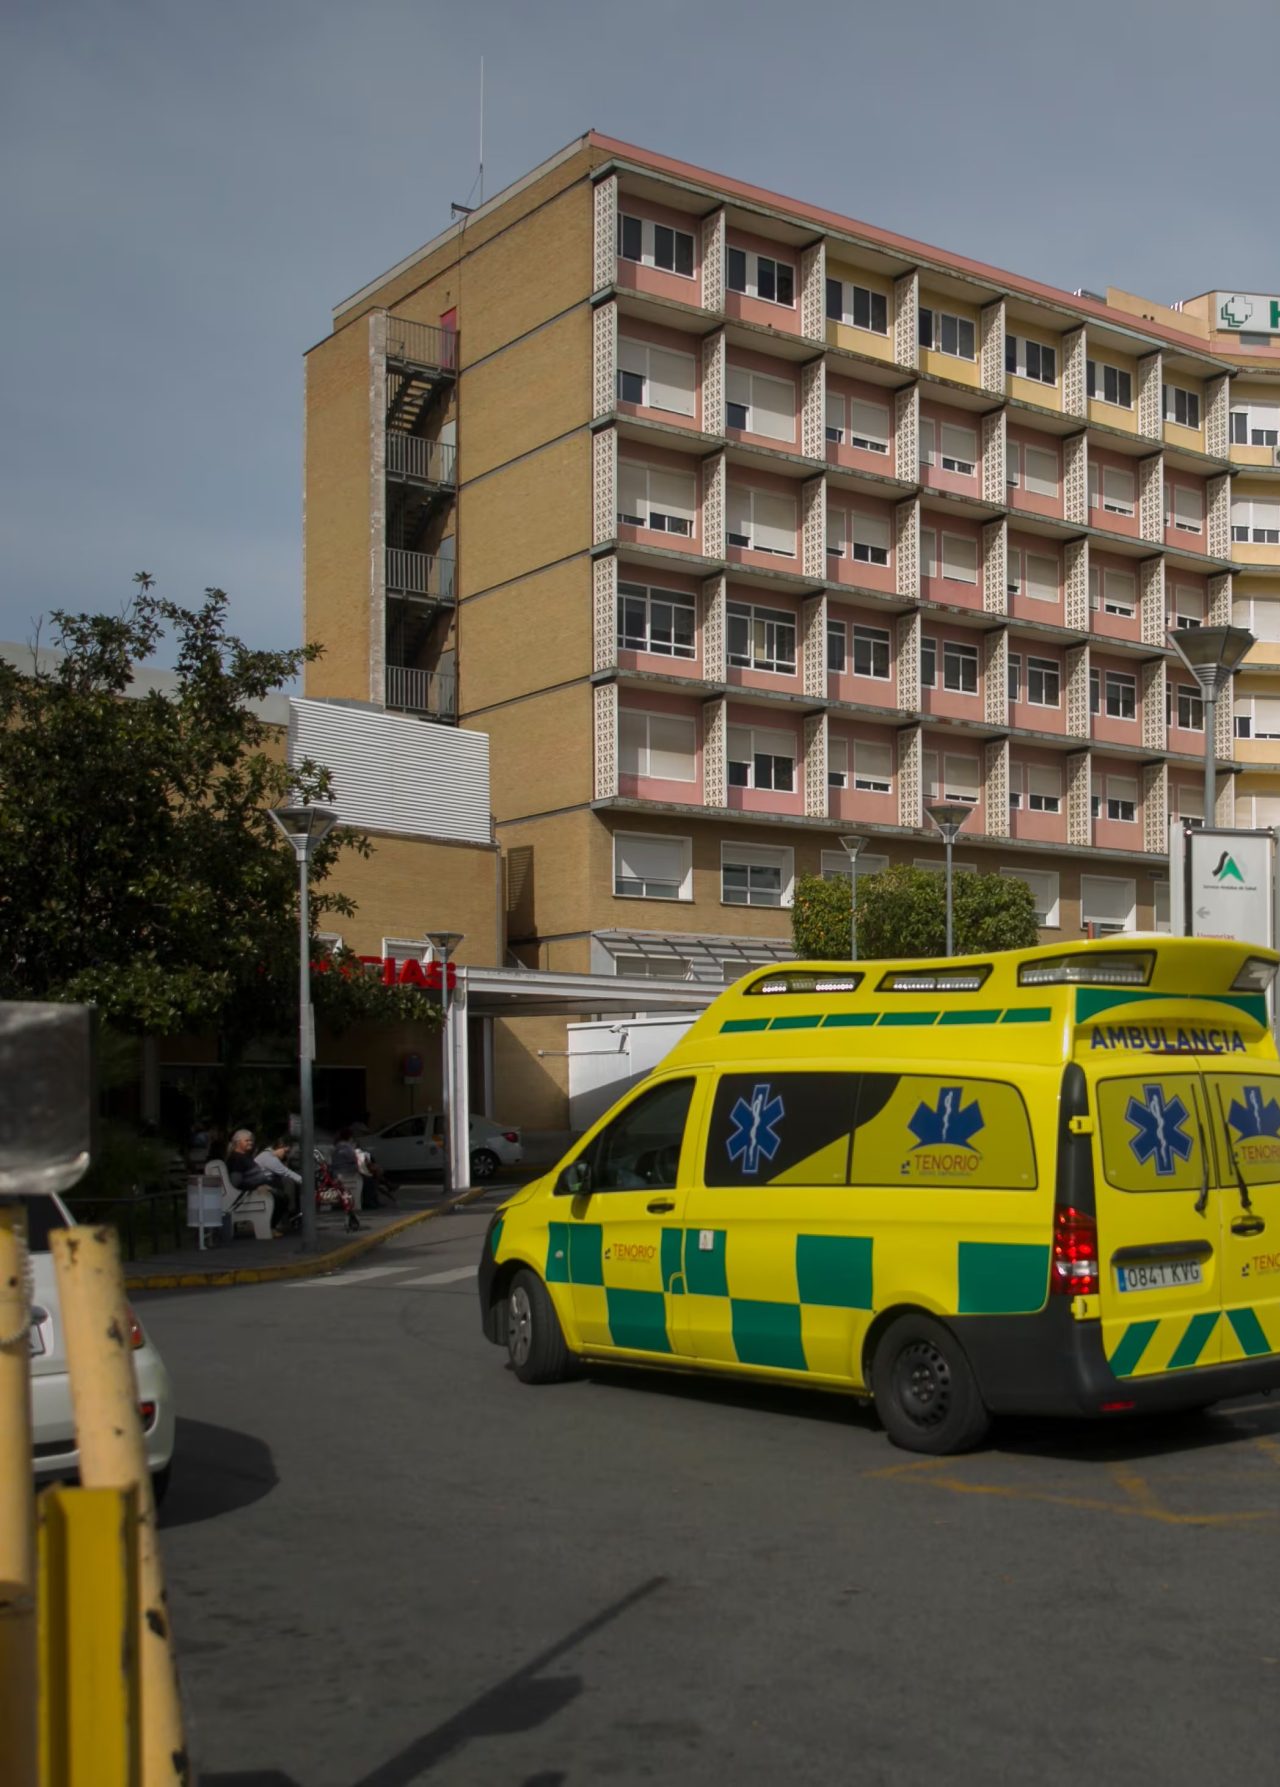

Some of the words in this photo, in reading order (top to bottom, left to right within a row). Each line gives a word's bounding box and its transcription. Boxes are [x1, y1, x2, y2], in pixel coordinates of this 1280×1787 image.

[1091, 1025, 1247, 1053] AMBULANCIA
[914, 1154, 979, 1171] TENORIO
[612, 1243, 656, 1259] TENORIO
[1127, 1264, 1166, 1288] 0841
[1170, 1261, 1200, 1284] KVG
